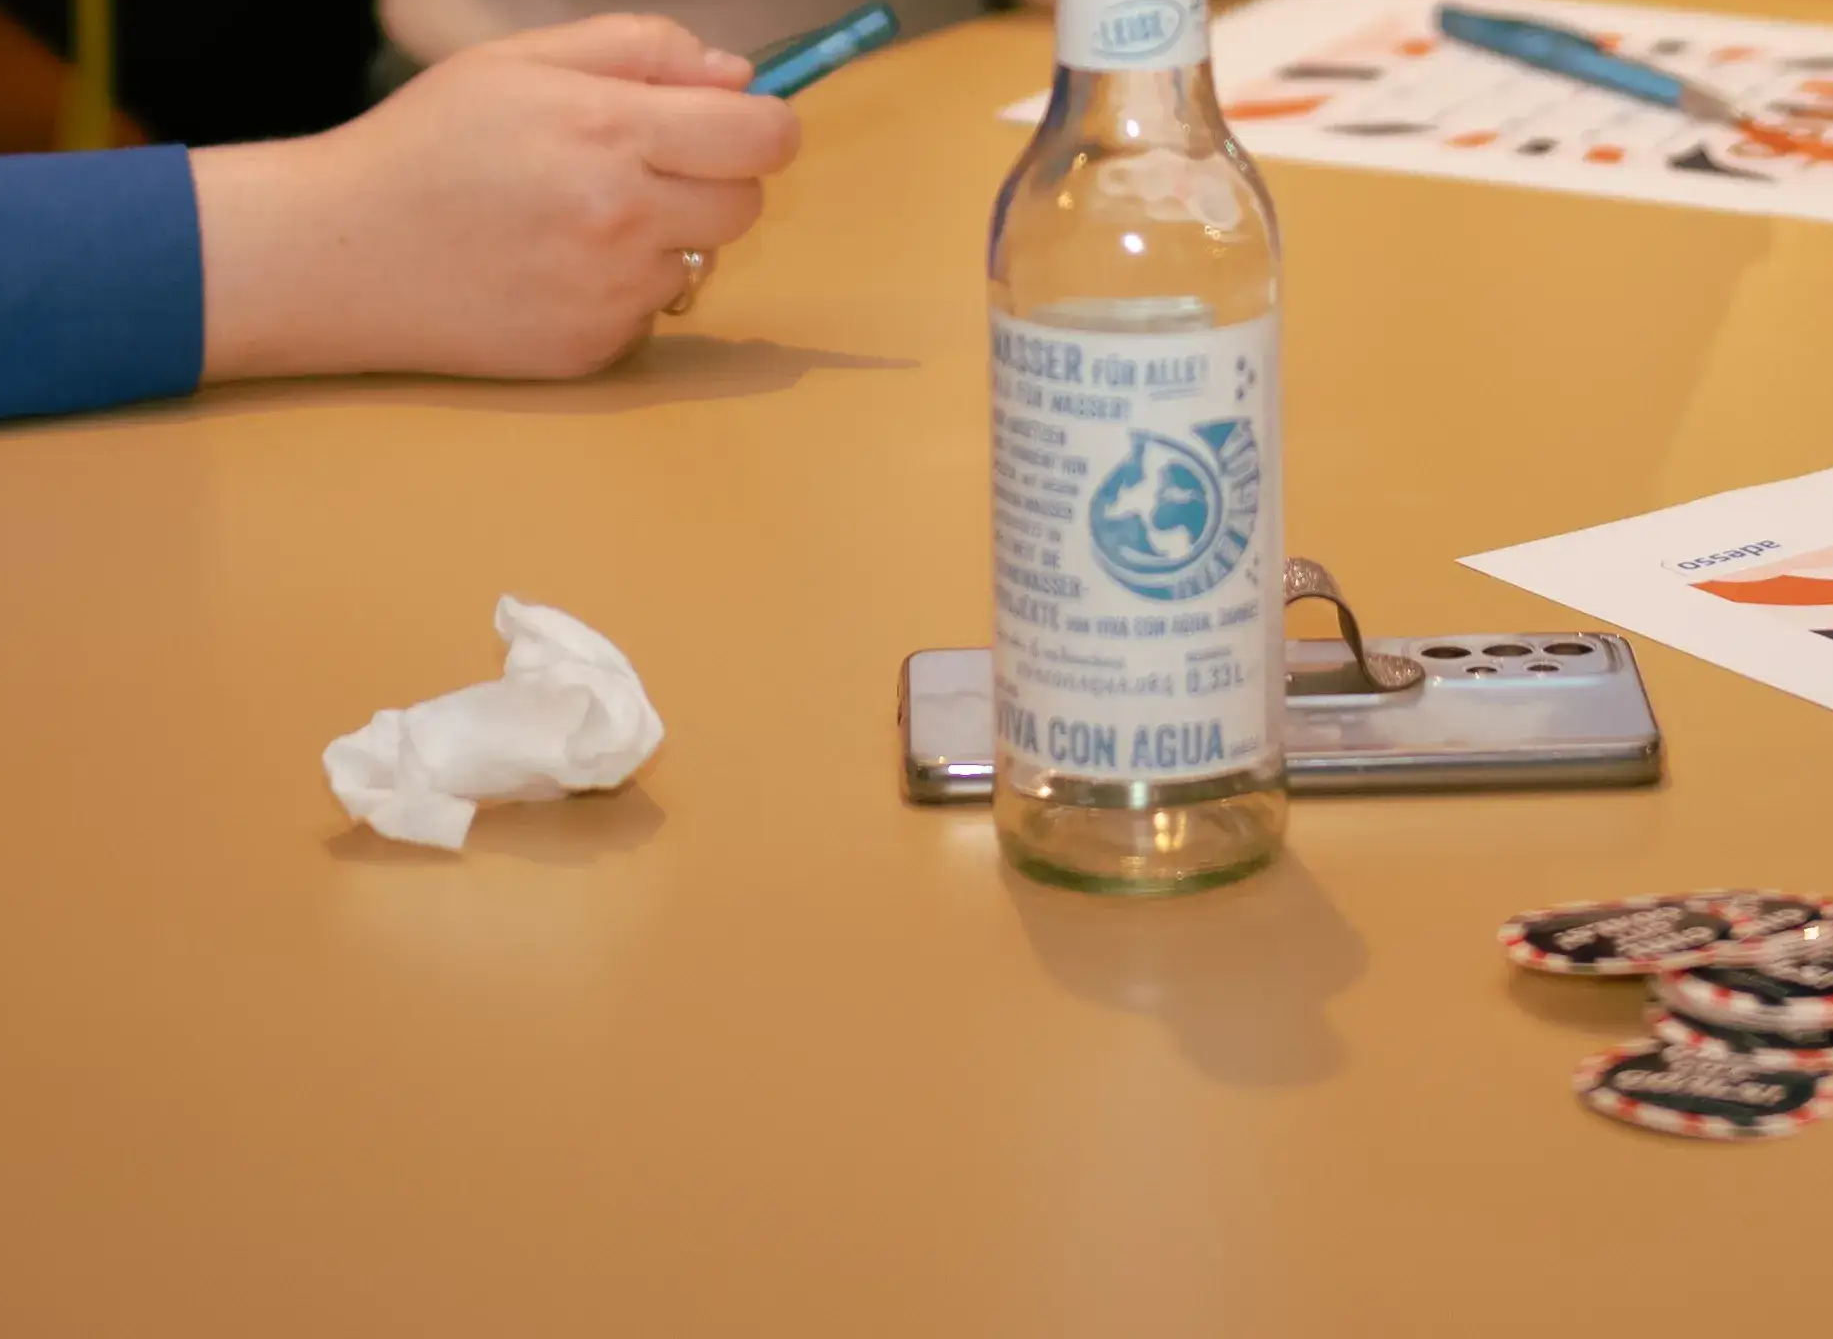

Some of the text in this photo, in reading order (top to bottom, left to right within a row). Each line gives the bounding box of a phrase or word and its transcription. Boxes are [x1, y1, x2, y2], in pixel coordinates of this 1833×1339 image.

[1677, 539, 1781, 570] adesso
[1047, 715, 1117, 769] CON
[1130, 717, 1226, 769] AGUA
